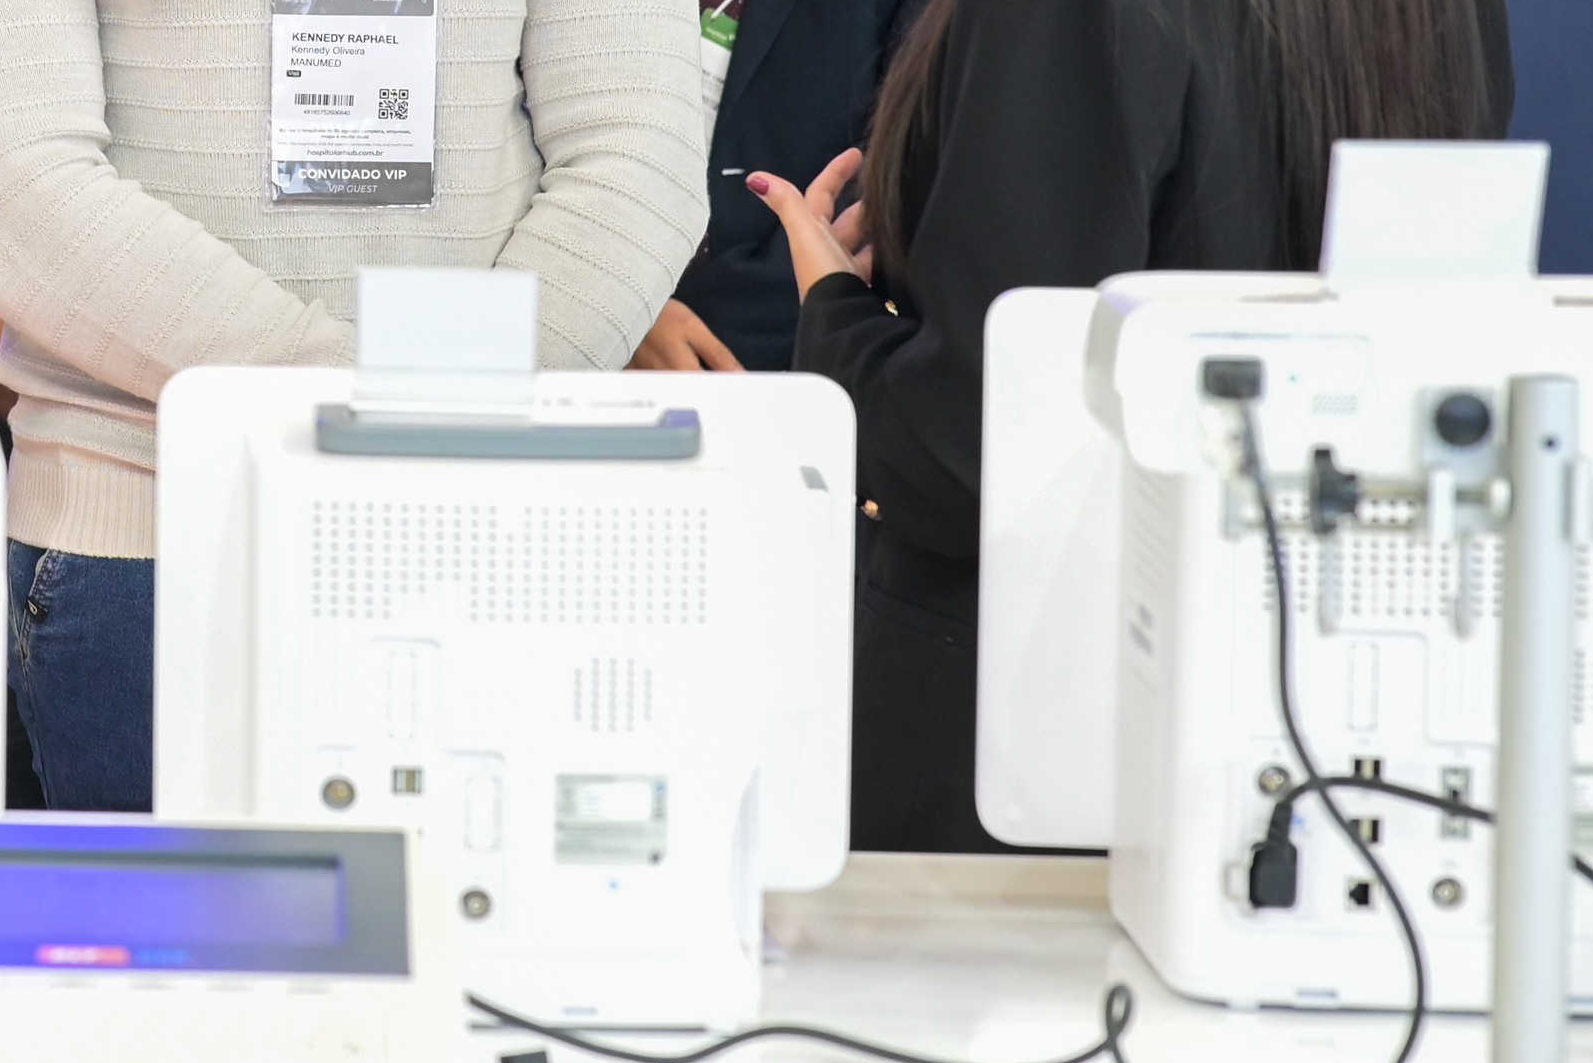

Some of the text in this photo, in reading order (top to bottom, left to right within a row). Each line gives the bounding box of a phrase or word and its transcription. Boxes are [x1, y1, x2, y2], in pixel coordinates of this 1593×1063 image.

[292, 32, 399, 45] KENNEDY RAPHAEL
[291, 45, 365, 56] Kennedy Oliveira
[290, 57, 342, 68] MANUMED
[306, 149, 384, 158] hospitalarhub.com.br
[298, 168, 407, 180] CONVIDADO VIP
[328, 184, 378, 194] VIP GUEST
